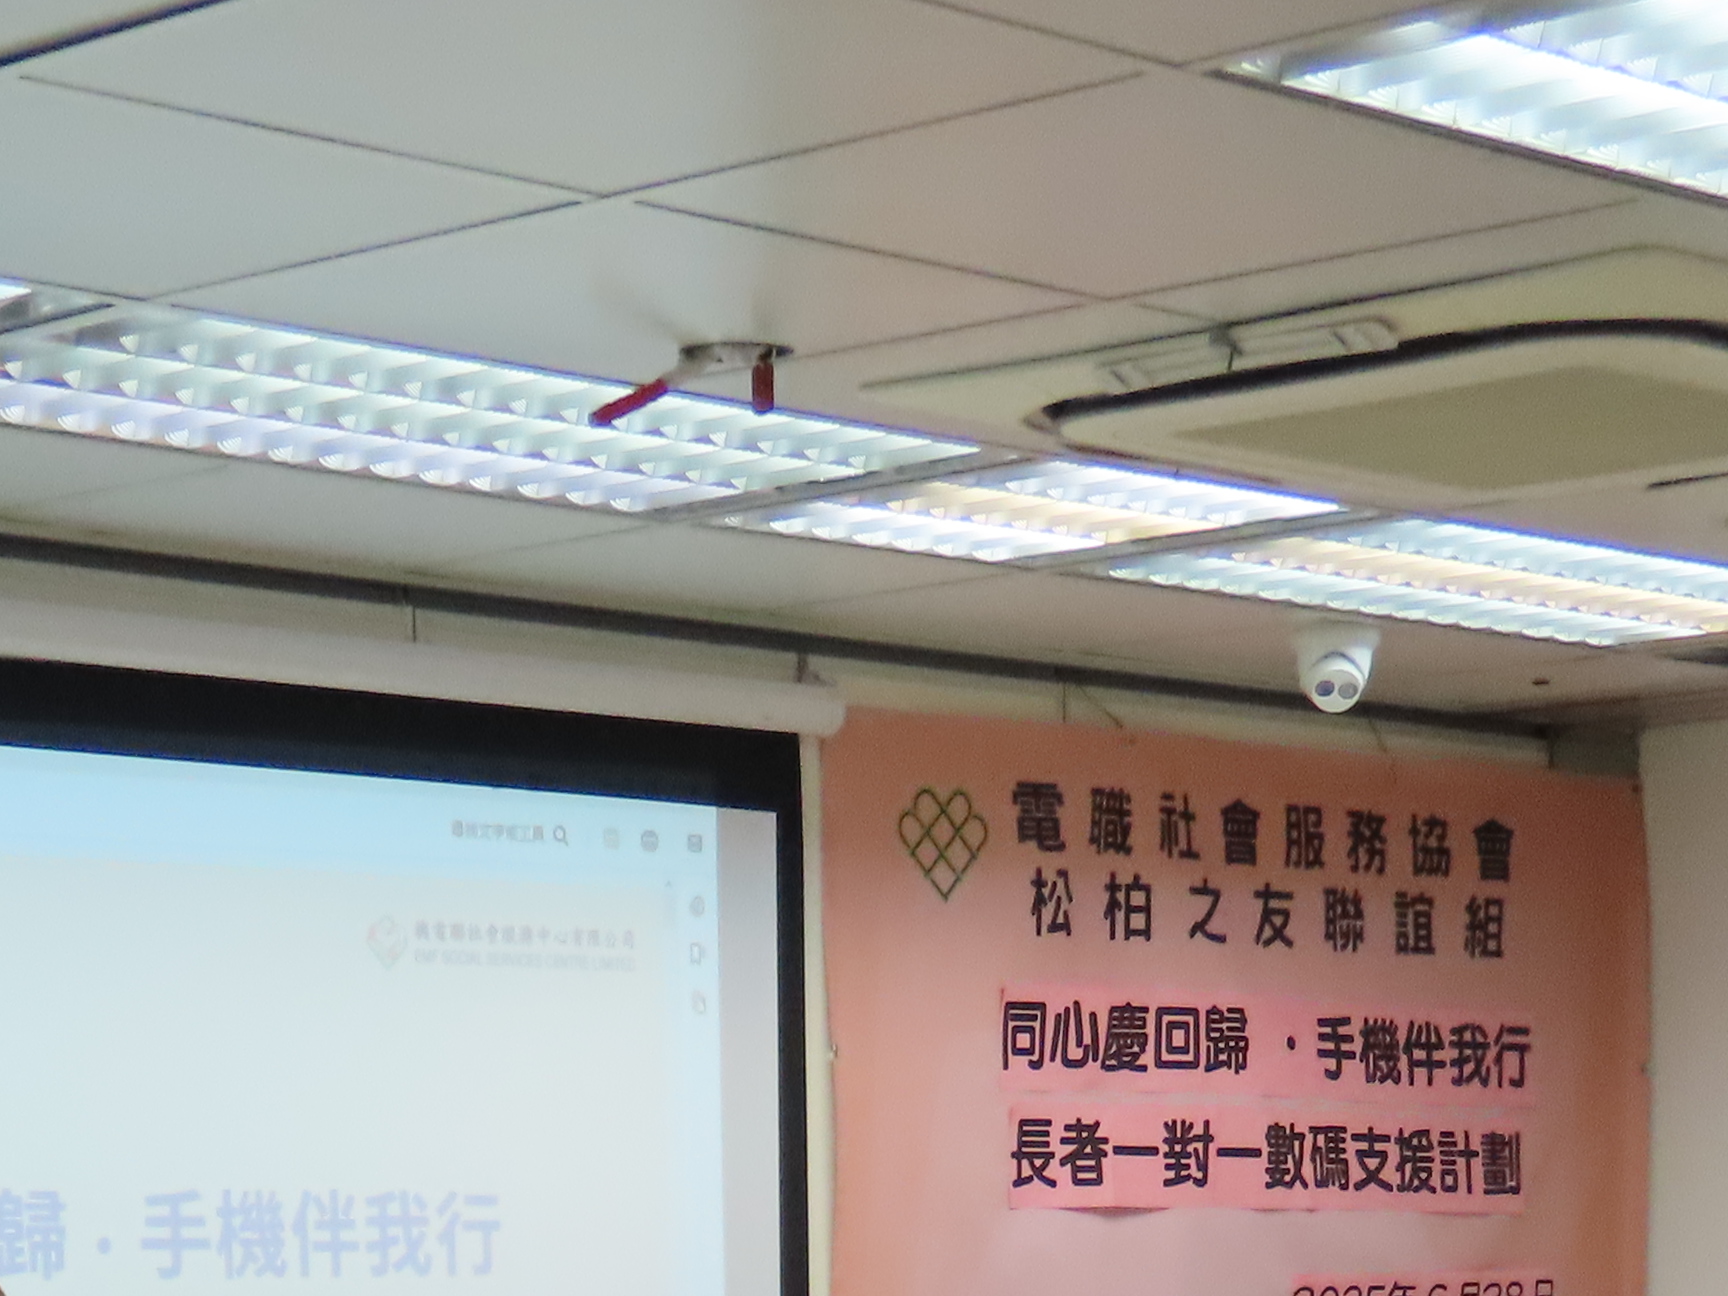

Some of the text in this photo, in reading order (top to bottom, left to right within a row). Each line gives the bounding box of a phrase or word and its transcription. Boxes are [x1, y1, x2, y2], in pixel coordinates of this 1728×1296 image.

[1012, 781, 1514, 883] 電職社會服務協會
[1030, 867, 1504, 958] 松柏之友聯誼組
[1011, 1118, 1521, 1196] 長者一對一數碼支援計劃
